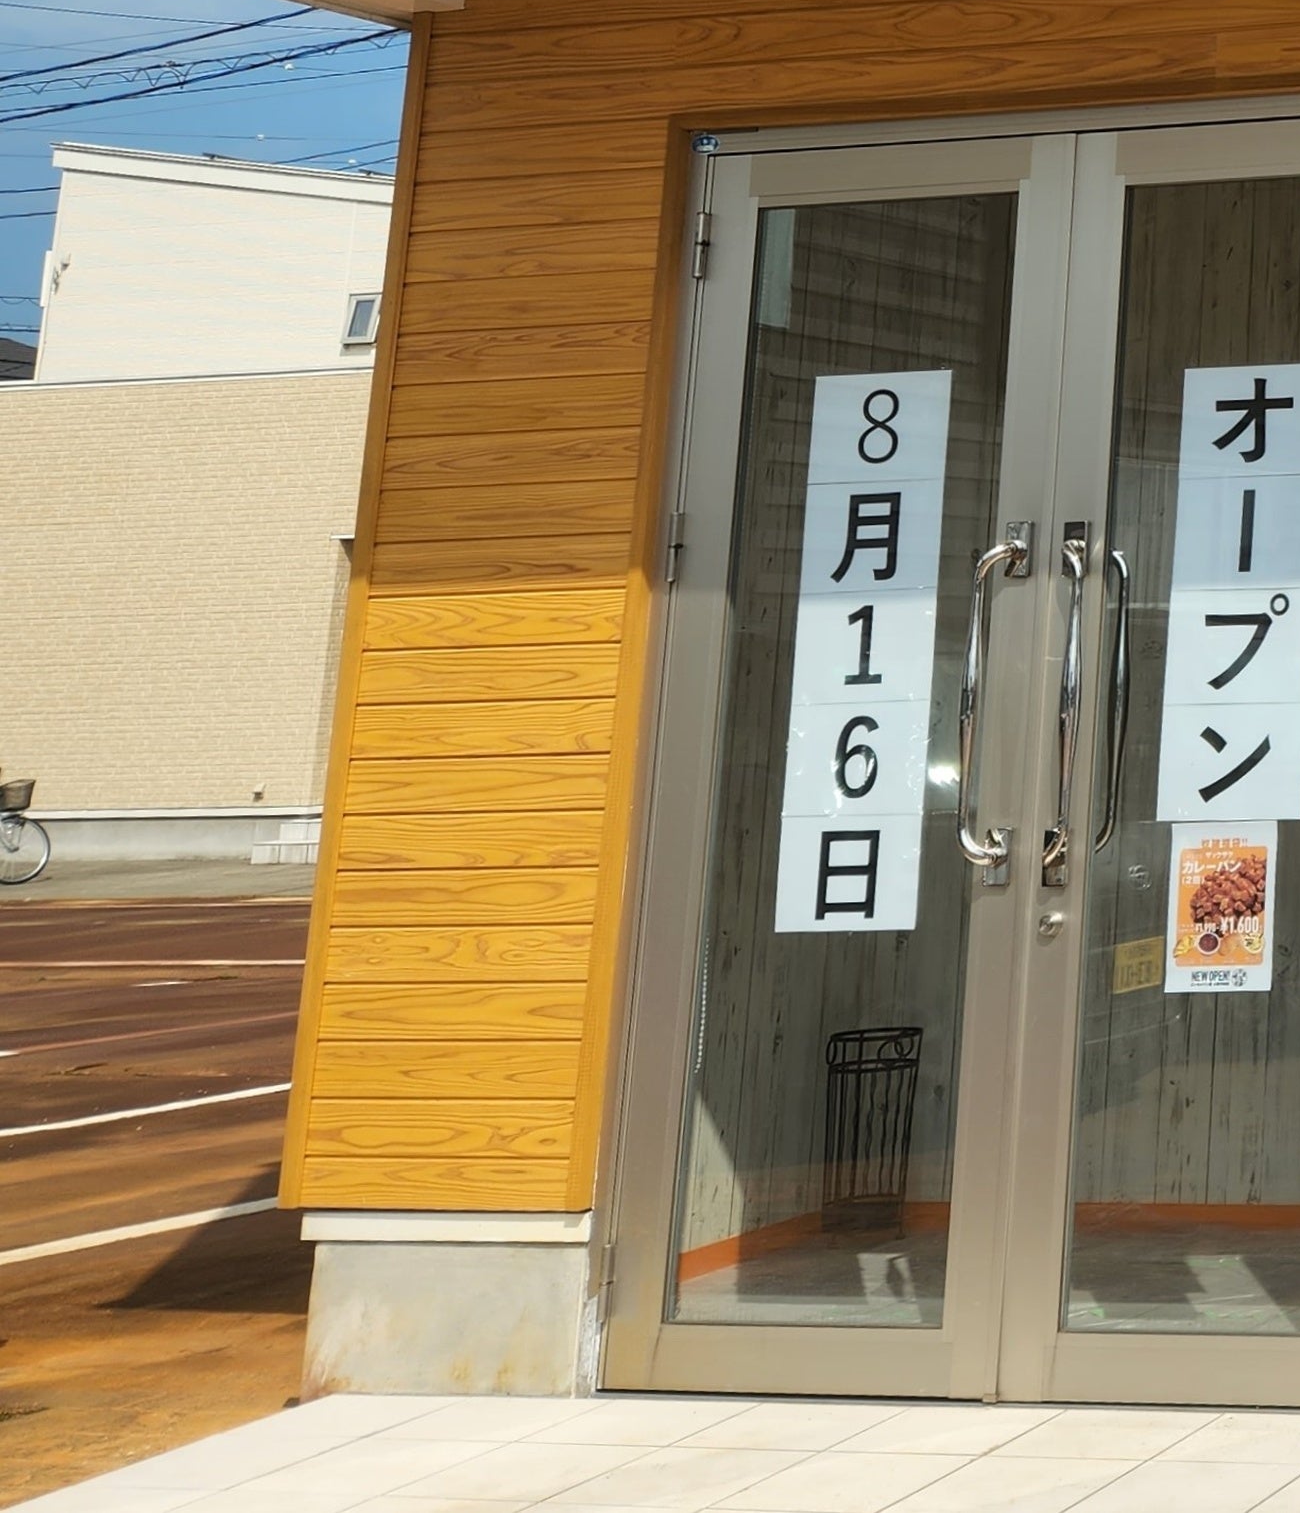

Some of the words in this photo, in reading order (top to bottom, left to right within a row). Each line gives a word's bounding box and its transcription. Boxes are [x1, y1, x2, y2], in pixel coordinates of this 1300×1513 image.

[814, 388, 902, 921] 8月16日
[1197, 378, 1294, 803] オープン
[1182, 860, 1242, 874] カレーパン
[1191, 971, 1208, 981] NEW
